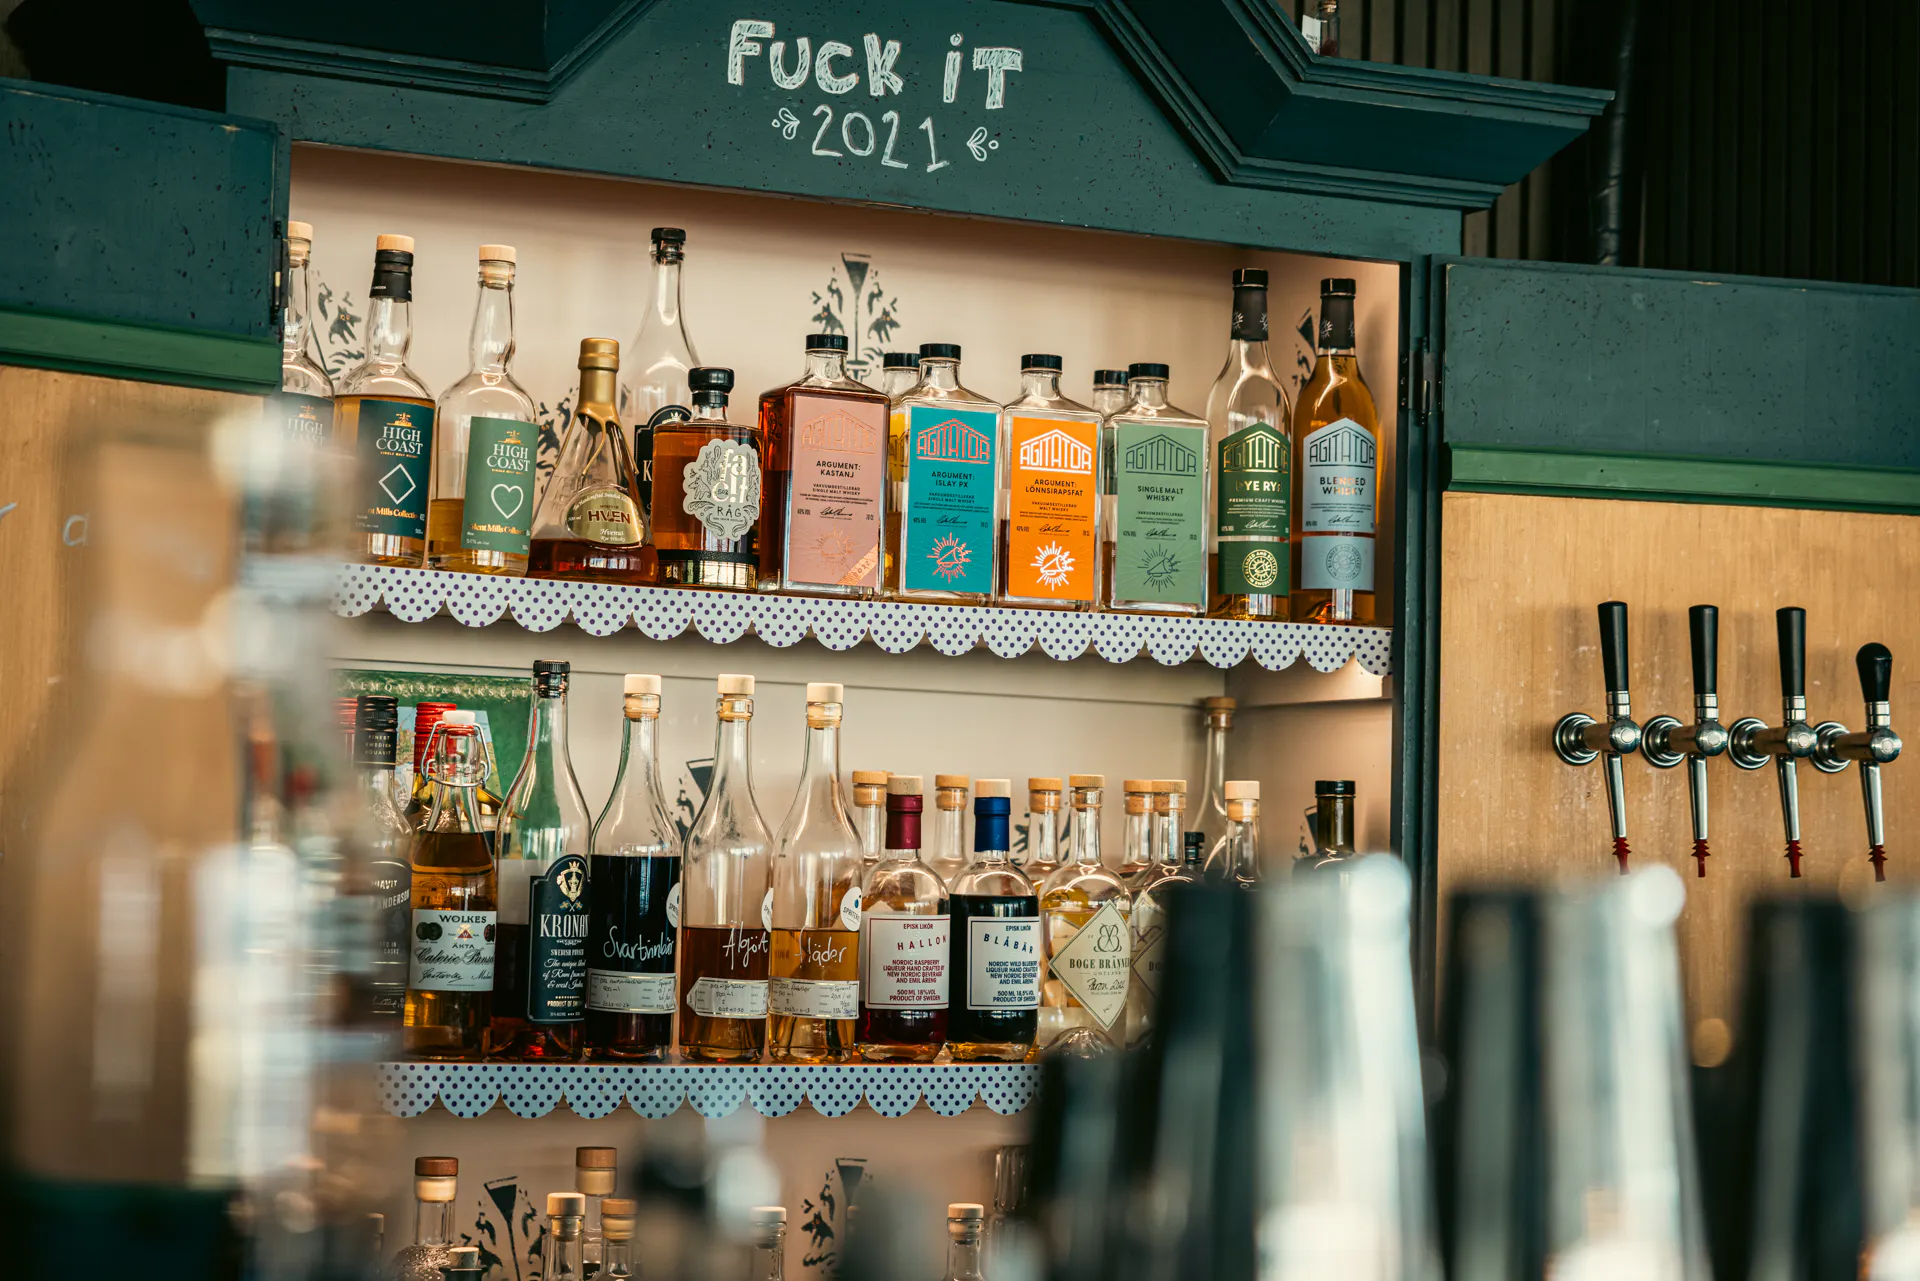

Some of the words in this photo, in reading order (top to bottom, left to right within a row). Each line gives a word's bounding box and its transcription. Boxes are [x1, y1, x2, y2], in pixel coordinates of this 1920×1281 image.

[728, 19, 904, 97] FUCK
[812, 104, 950, 172] 2021
[382, 426, 421, 442] HIGH
[801, 413, 876, 450] AGITATOR
[376, 437, 423, 454] COAST
[917, 424, 990, 460] AGITATOR
[1310, 431, 1374, 464] AGITATOR
[493, 444, 528, 459] HIGH
[1020, 434, 1092, 470] AGITATOR
[1126, 438, 1196, 472] AGITATOR
[486, 455, 530, 472] COAST
[816, 460, 860, 470] ARGUMENT:
[820, 469, 854, 478] KASTANJ
[932, 471, 975, 480] ARGUMENT:
[1320, 476, 1366, 486] BLENDED
[1026, 485, 1083, 496] LÖNNSIRAPSFAT
[1034, 479, 1077, 488] ARGUMENT:
[1138, 486, 1164, 494] SINGLE
[1322, 487, 1364, 496] WHISKY
[717, 504, 742, 518] RÅG
[439, 914, 487, 924] WOLKES
[897, 935, 946, 950] HALLON
[984, 933, 1033, 954] BLÅBÄR
[1069, 958, 1096, 969] BOGE
